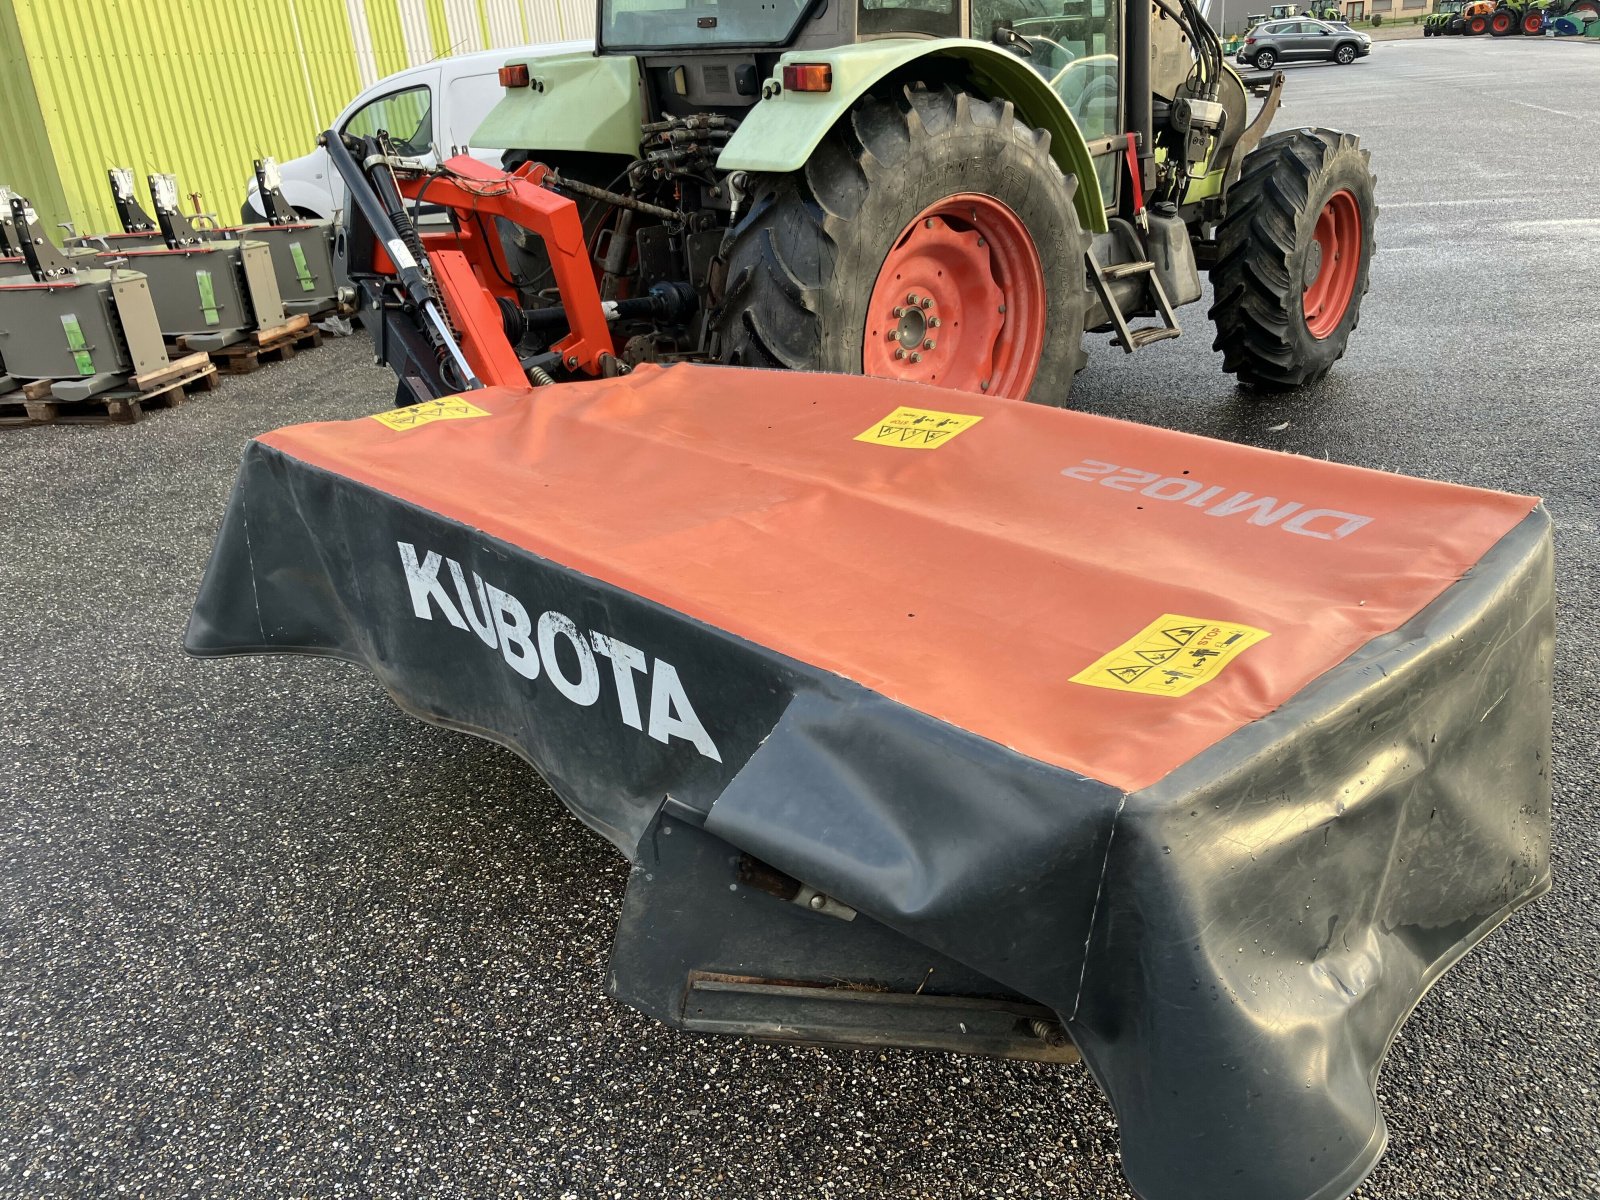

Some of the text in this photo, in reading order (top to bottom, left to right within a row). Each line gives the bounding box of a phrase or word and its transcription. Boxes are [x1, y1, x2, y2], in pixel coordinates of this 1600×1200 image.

[1061, 458, 1375, 541] DM1022
[397, 541, 722, 763] KUBOTA
[1197, 627, 1222, 646] STOP
